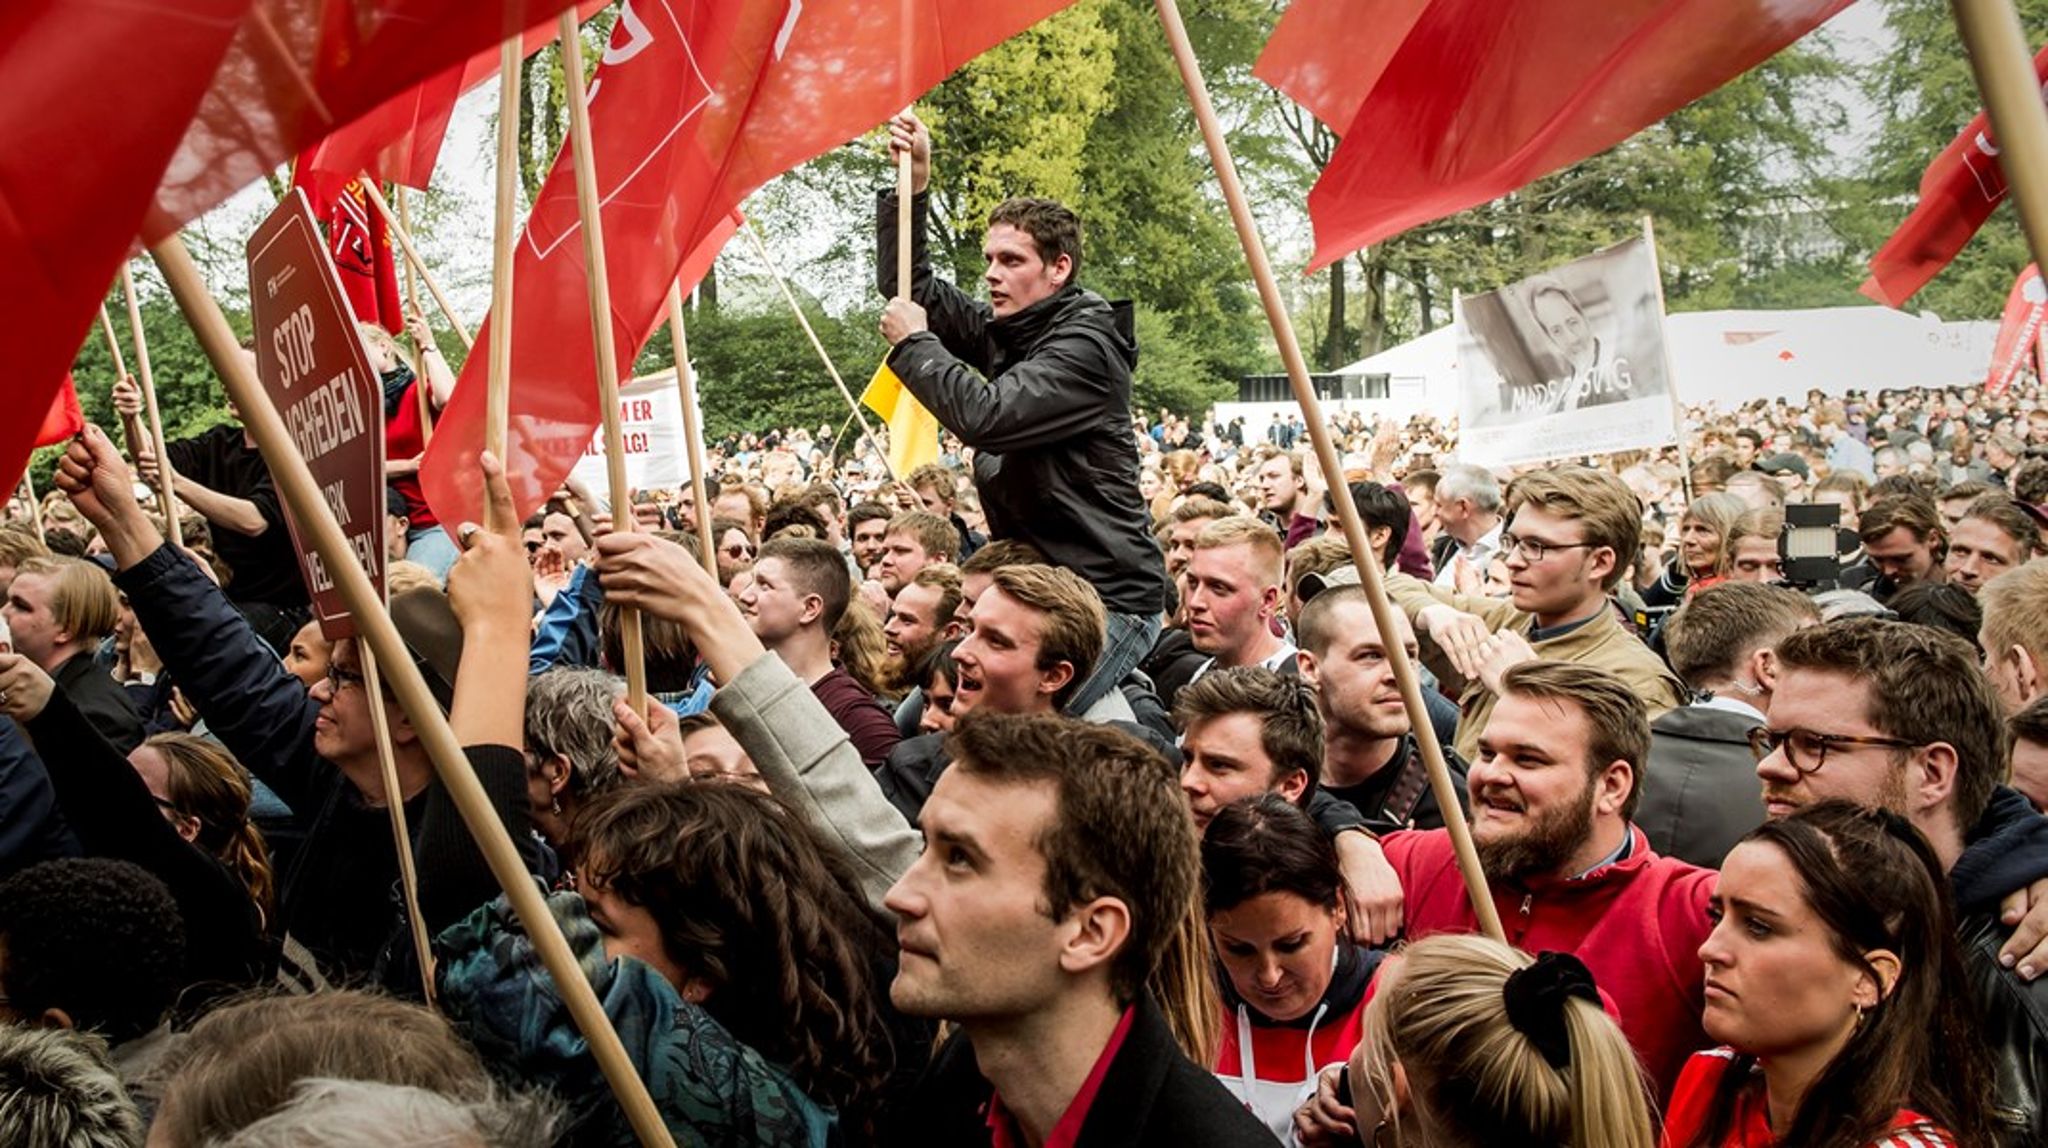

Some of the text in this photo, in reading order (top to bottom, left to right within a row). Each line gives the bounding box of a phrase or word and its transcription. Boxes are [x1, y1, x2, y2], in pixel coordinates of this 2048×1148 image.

[273, 303, 316, 389] STOP
[1562, 358, 1632, 403] SVIG
[633, 400, 653, 421] ER
